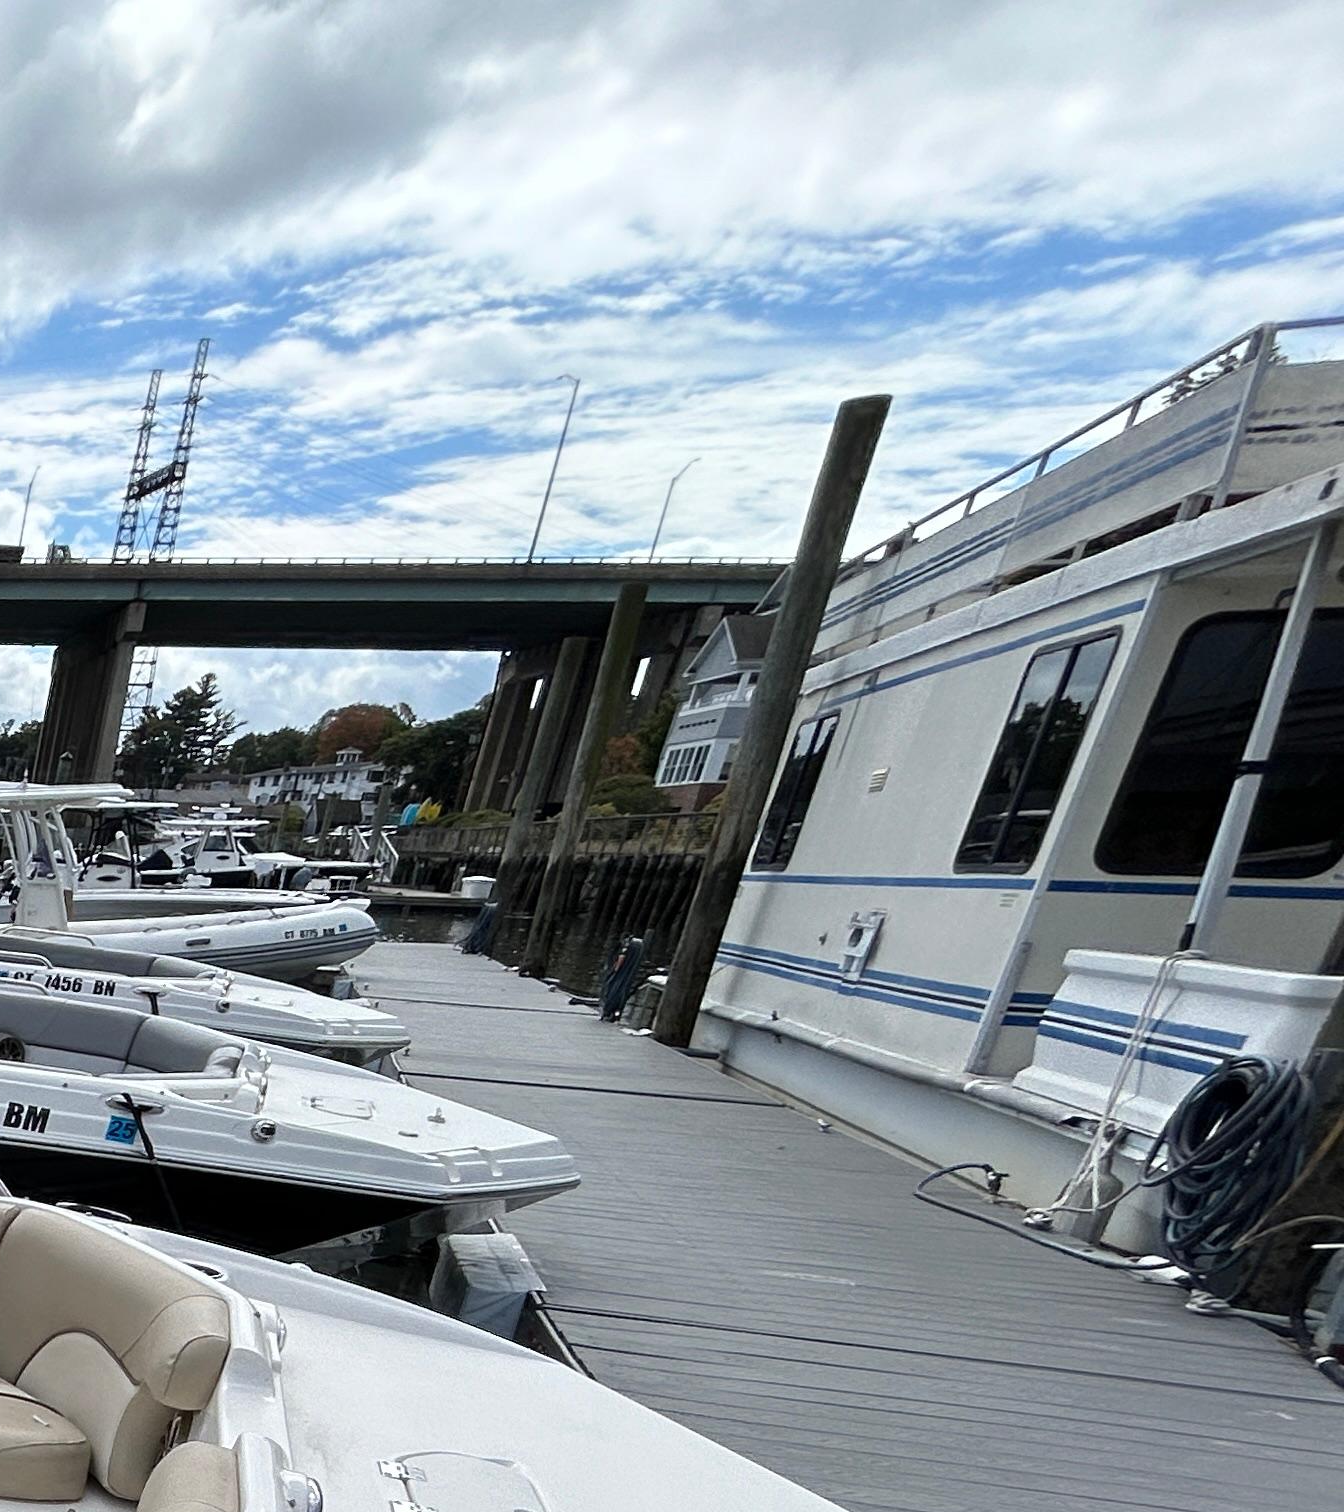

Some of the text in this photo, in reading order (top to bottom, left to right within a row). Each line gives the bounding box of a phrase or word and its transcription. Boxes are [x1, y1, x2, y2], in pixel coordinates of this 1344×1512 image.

[44, 974, 84, 993] 7456
[92, 979, 116, 997] BN
[3, 1101, 51, 1134] BM
[109, 1120, 138, 1140] 25
